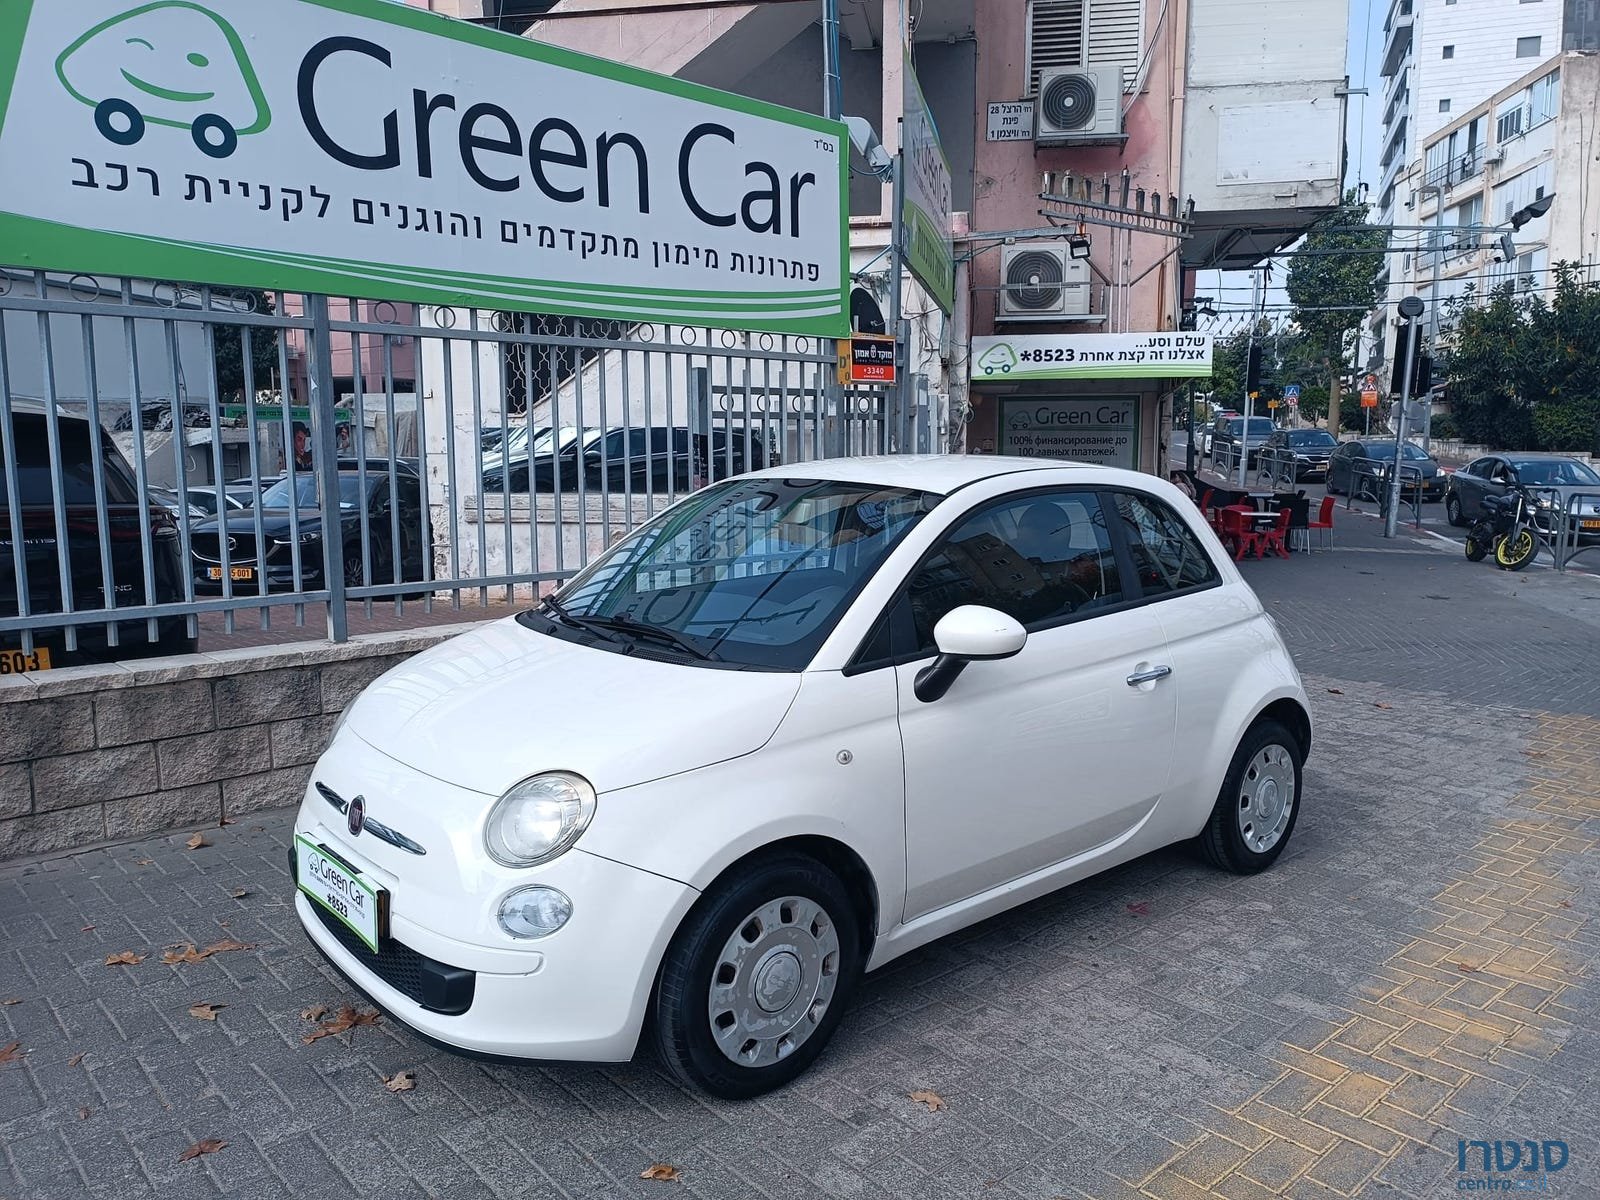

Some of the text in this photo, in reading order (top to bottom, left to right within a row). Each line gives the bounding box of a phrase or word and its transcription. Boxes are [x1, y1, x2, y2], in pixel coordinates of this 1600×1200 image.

[990, 106, 1000, 114] 28
[1001, 103, 1022, 114] הרצל
[1002, 116, 1019, 125] פינת
[297, 36, 650, 214] Green
[678, 122, 816, 238] Car
[72, 157, 819, 282] פתרונות מימון מתקדמים והוגנים לקניית רכב
[1135, 335, 1205, 347] שלם וסע...
[855, 349, 893, 360] מוקד אמון
[1079, 351, 1115, 361] אחרת
[1117, 350, 1145, 363] קצת
[1150, 350, 1164, 360] זה
[1168, 348, 1205, 360] אצלנו
[1035, 406, 1129, 425] Green Car
[1009, 435, 1128, 447] 100% финансирование до
[1018, 447, 1034, 457] 100
[1072, 446, 1118, 457] платежей.
[98, 584, 132, 593] TNG
[320, 858, 348, 895] Green
[349, 880, 365, 908] Car
